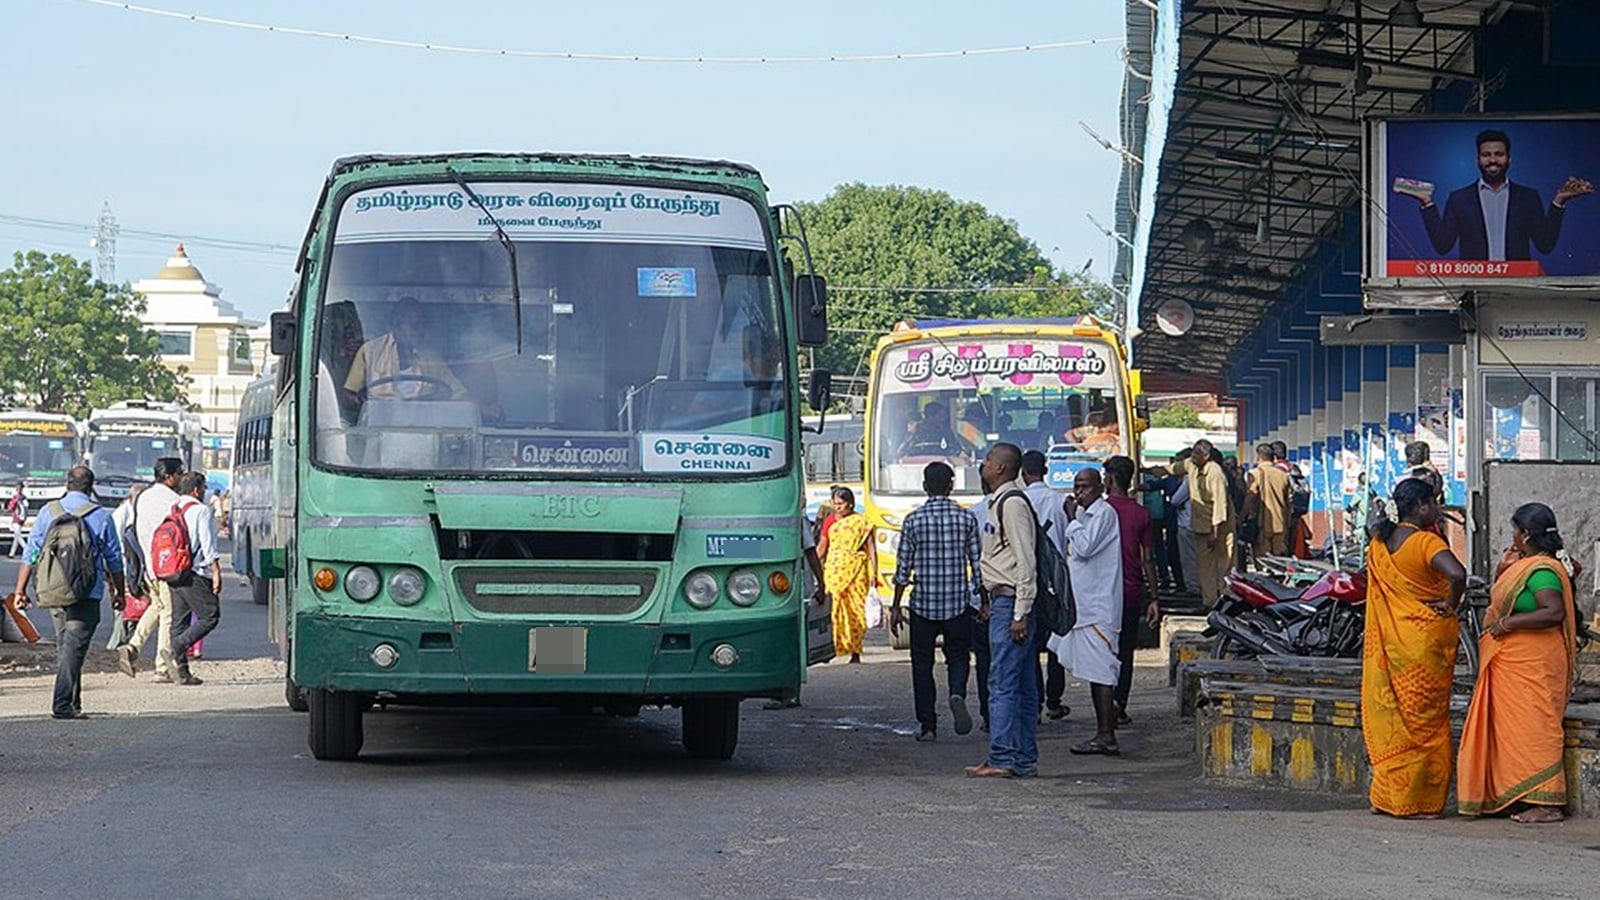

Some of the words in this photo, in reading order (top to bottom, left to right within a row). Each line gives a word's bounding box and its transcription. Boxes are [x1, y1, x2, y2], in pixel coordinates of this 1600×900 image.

[356, 190, 463, 213] தமிழ்நாடு
[468, 193, 525, 211] அரசு
[528, 191, 626, 212] விரைவுப்
[631, 193, 720, 217] பேருந்து
[538, 216, 601, 230] பேருந்து
[1430, 263, 1451, 274] 810
[1455, 263, 1484, 274] 8000
[1487, 263, 1509, 274] 847
[522, 439, 629, 463] சென்னை
[654, 435, 773, 459] சென்னை
[680, 459, 751, 470] CHENNAI
